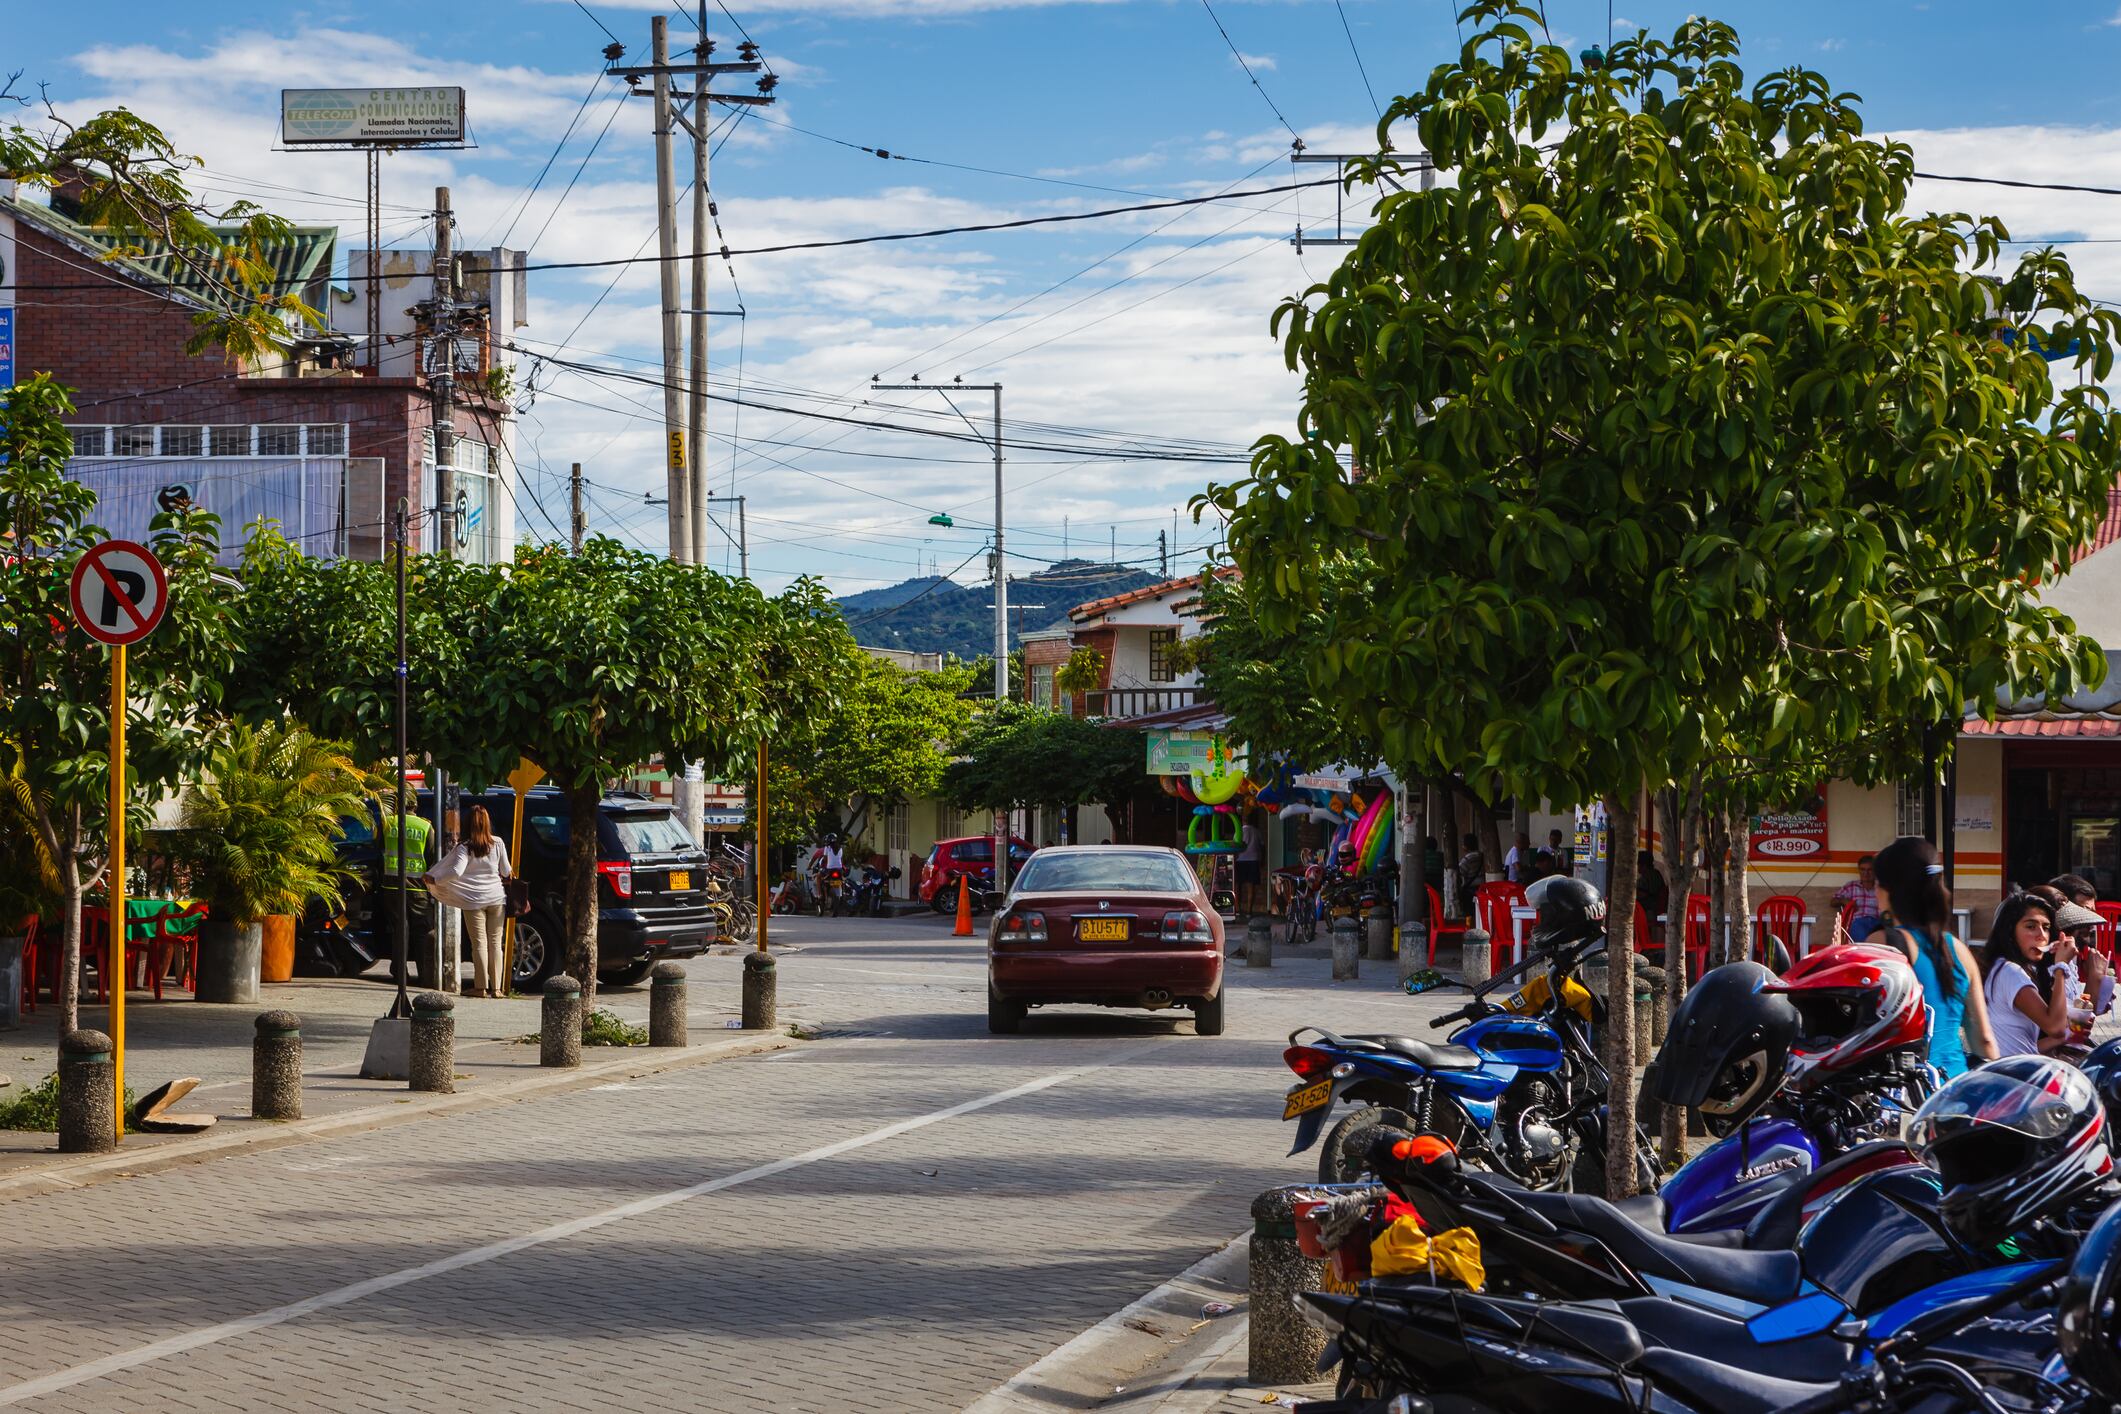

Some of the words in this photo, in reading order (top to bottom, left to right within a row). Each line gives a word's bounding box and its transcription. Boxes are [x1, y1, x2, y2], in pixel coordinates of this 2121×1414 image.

[370, 90, 446, 101] CENTRO
[290, 110, 354, 120] TELECOM
[359, 103, 458, 117] COMUNICACIONES
[368, 118, 405, 126] Llamadas
[408, 117, 454, 127] Nacionales,
[360, 128, 420, 136] Internacionales
[430, 127, 459, 135] Celular
[101, 568, 146, 627] P
[1791, 814, 1818, 822] Asado
[1754, 828, 1779, 836] arepa
[1790, 827, 1824, 835] maduro
[1766, 841, 1812, 852] $18.990
[1735, 1154, 1801, 1183] SUZUKI
